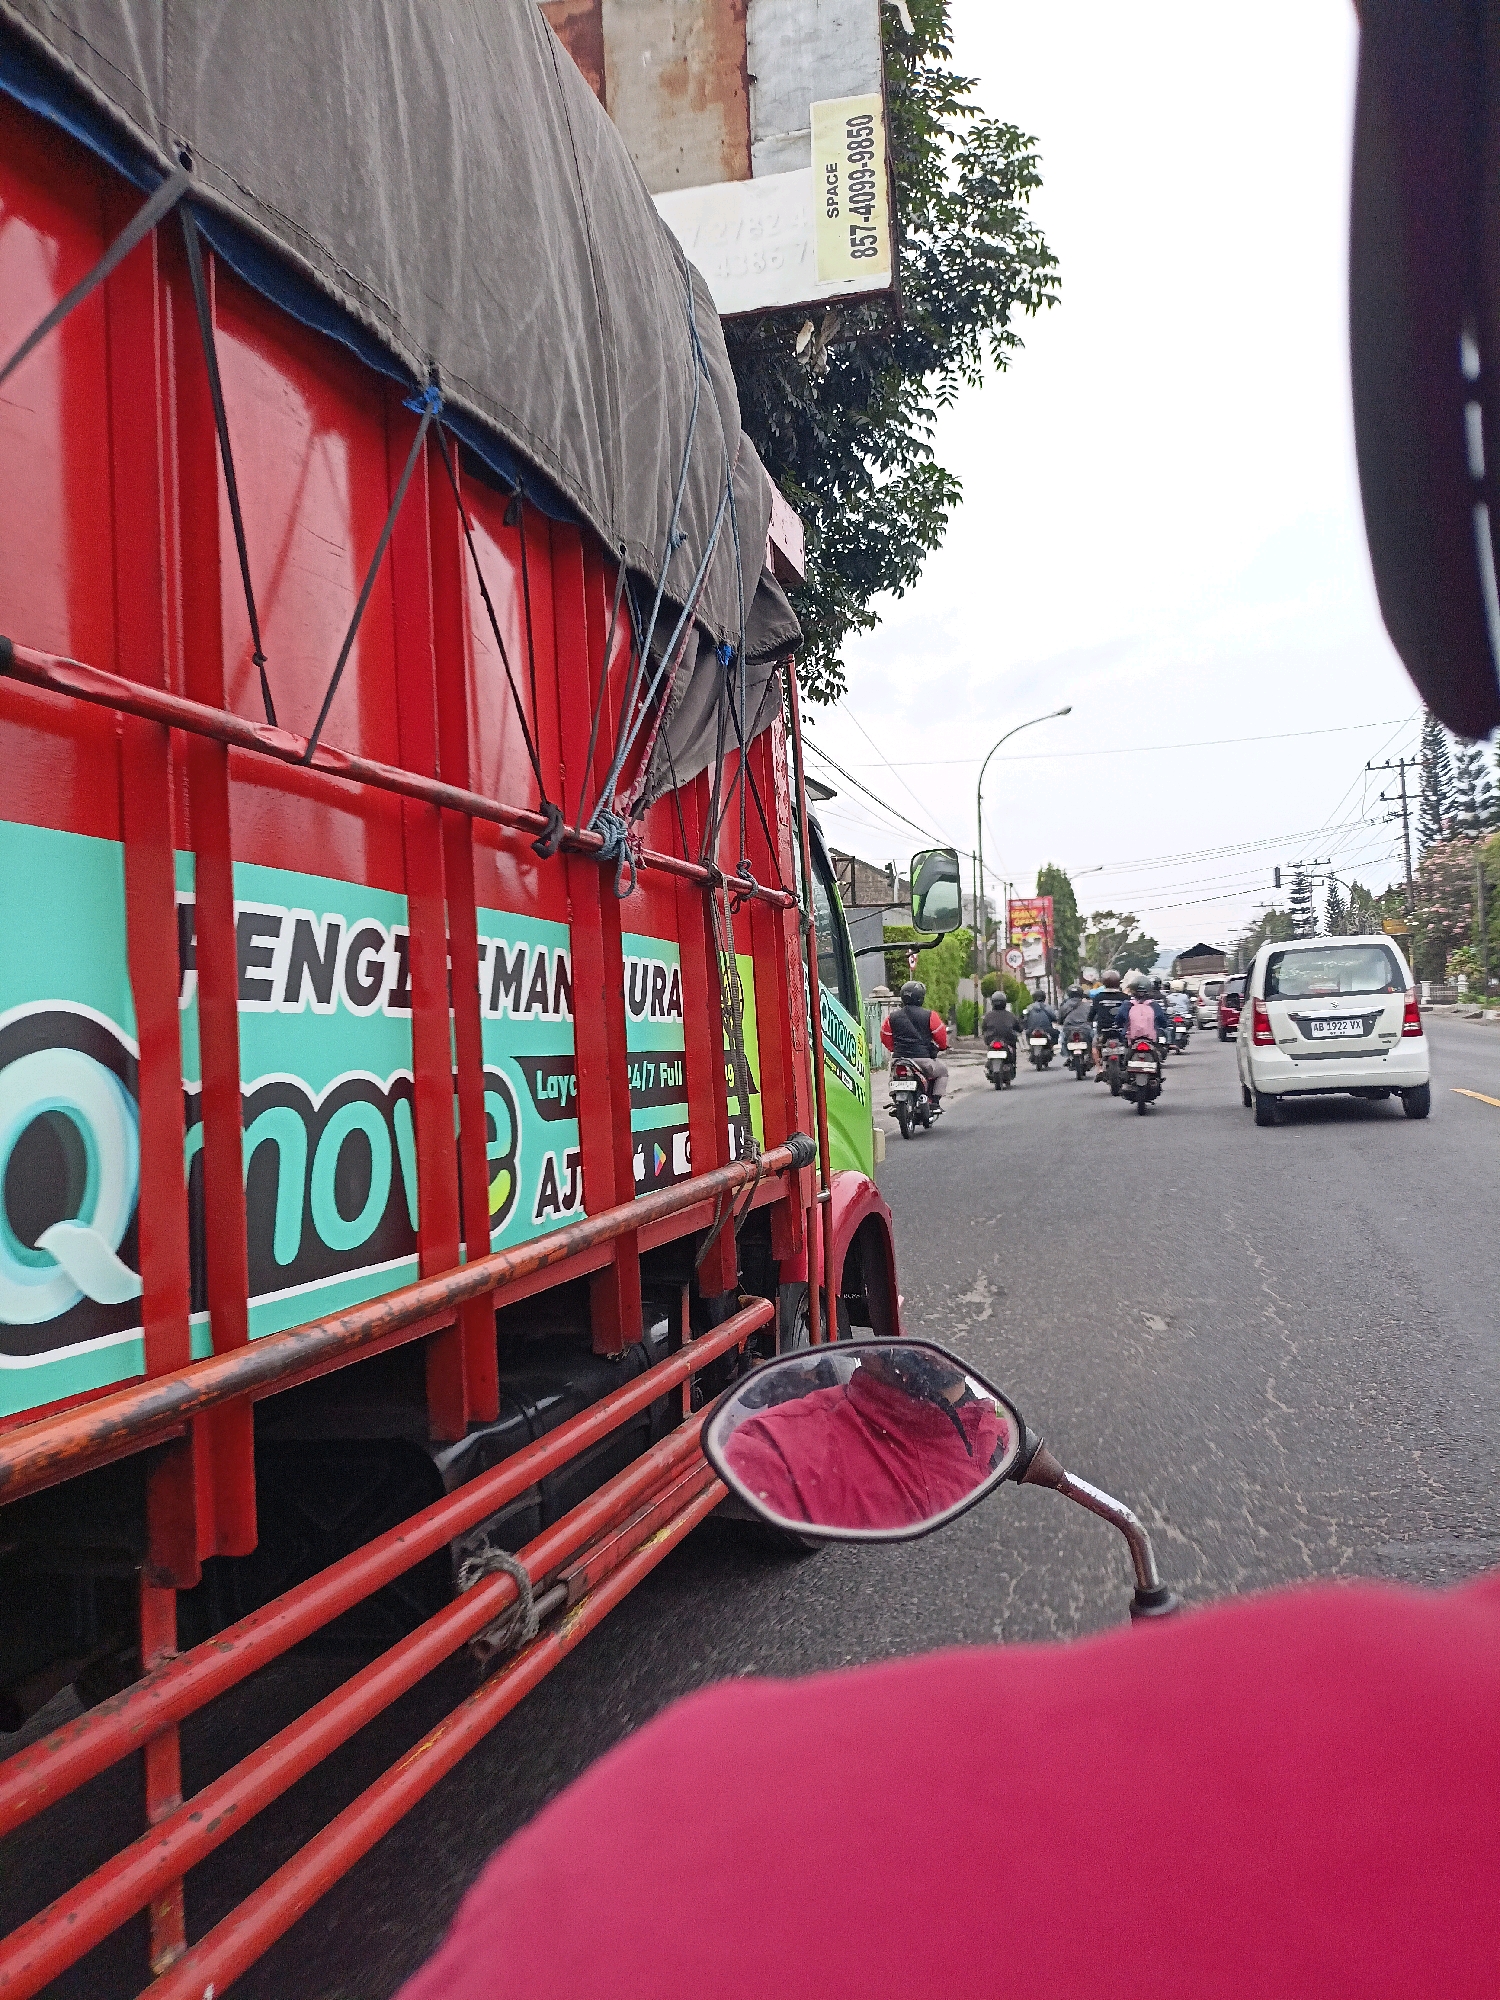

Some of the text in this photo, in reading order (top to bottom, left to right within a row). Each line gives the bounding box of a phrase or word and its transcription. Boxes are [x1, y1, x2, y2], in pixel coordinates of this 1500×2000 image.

[826, 162, 840, 219] SPACE
[845, 114, 878, 259] 857-4099-9850
[1313, 1020, 1361, 1032] AB 1922 VX
[628, 1061, 656, 1092] 4/7
[659, 1060, 683, 1088] Full
